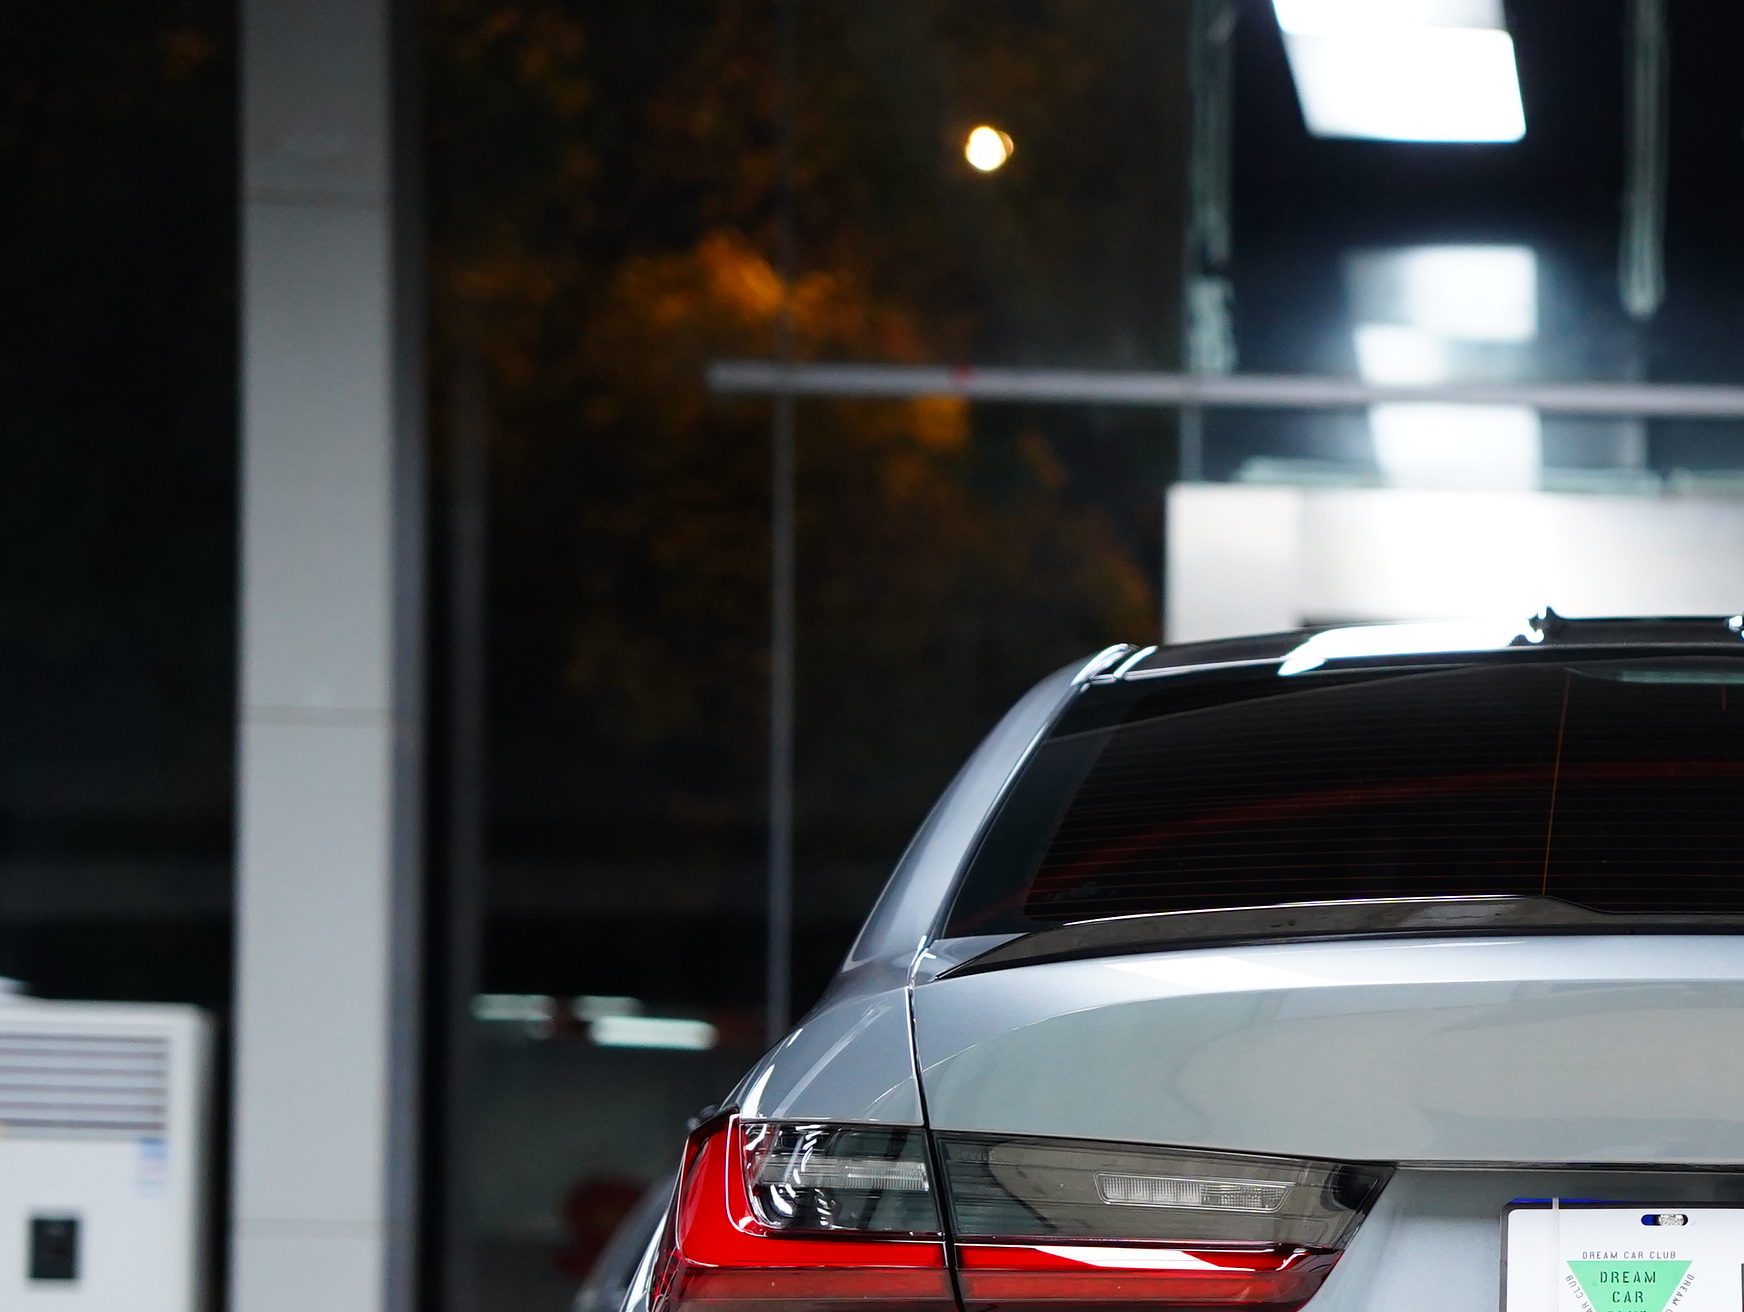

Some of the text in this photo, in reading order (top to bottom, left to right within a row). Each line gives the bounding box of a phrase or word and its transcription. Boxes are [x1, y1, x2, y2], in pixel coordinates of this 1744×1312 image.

[1582, 1251, 1676, 1260] DREAM CAR CLUB
[1600, 1271, 1656, 1283] DREAM
[1565, 1275, 1584, 1299] CLUB
[1671, 1273, 1695, 1306] DREAM
[1612, 1291, 1644, 1303] CAR
